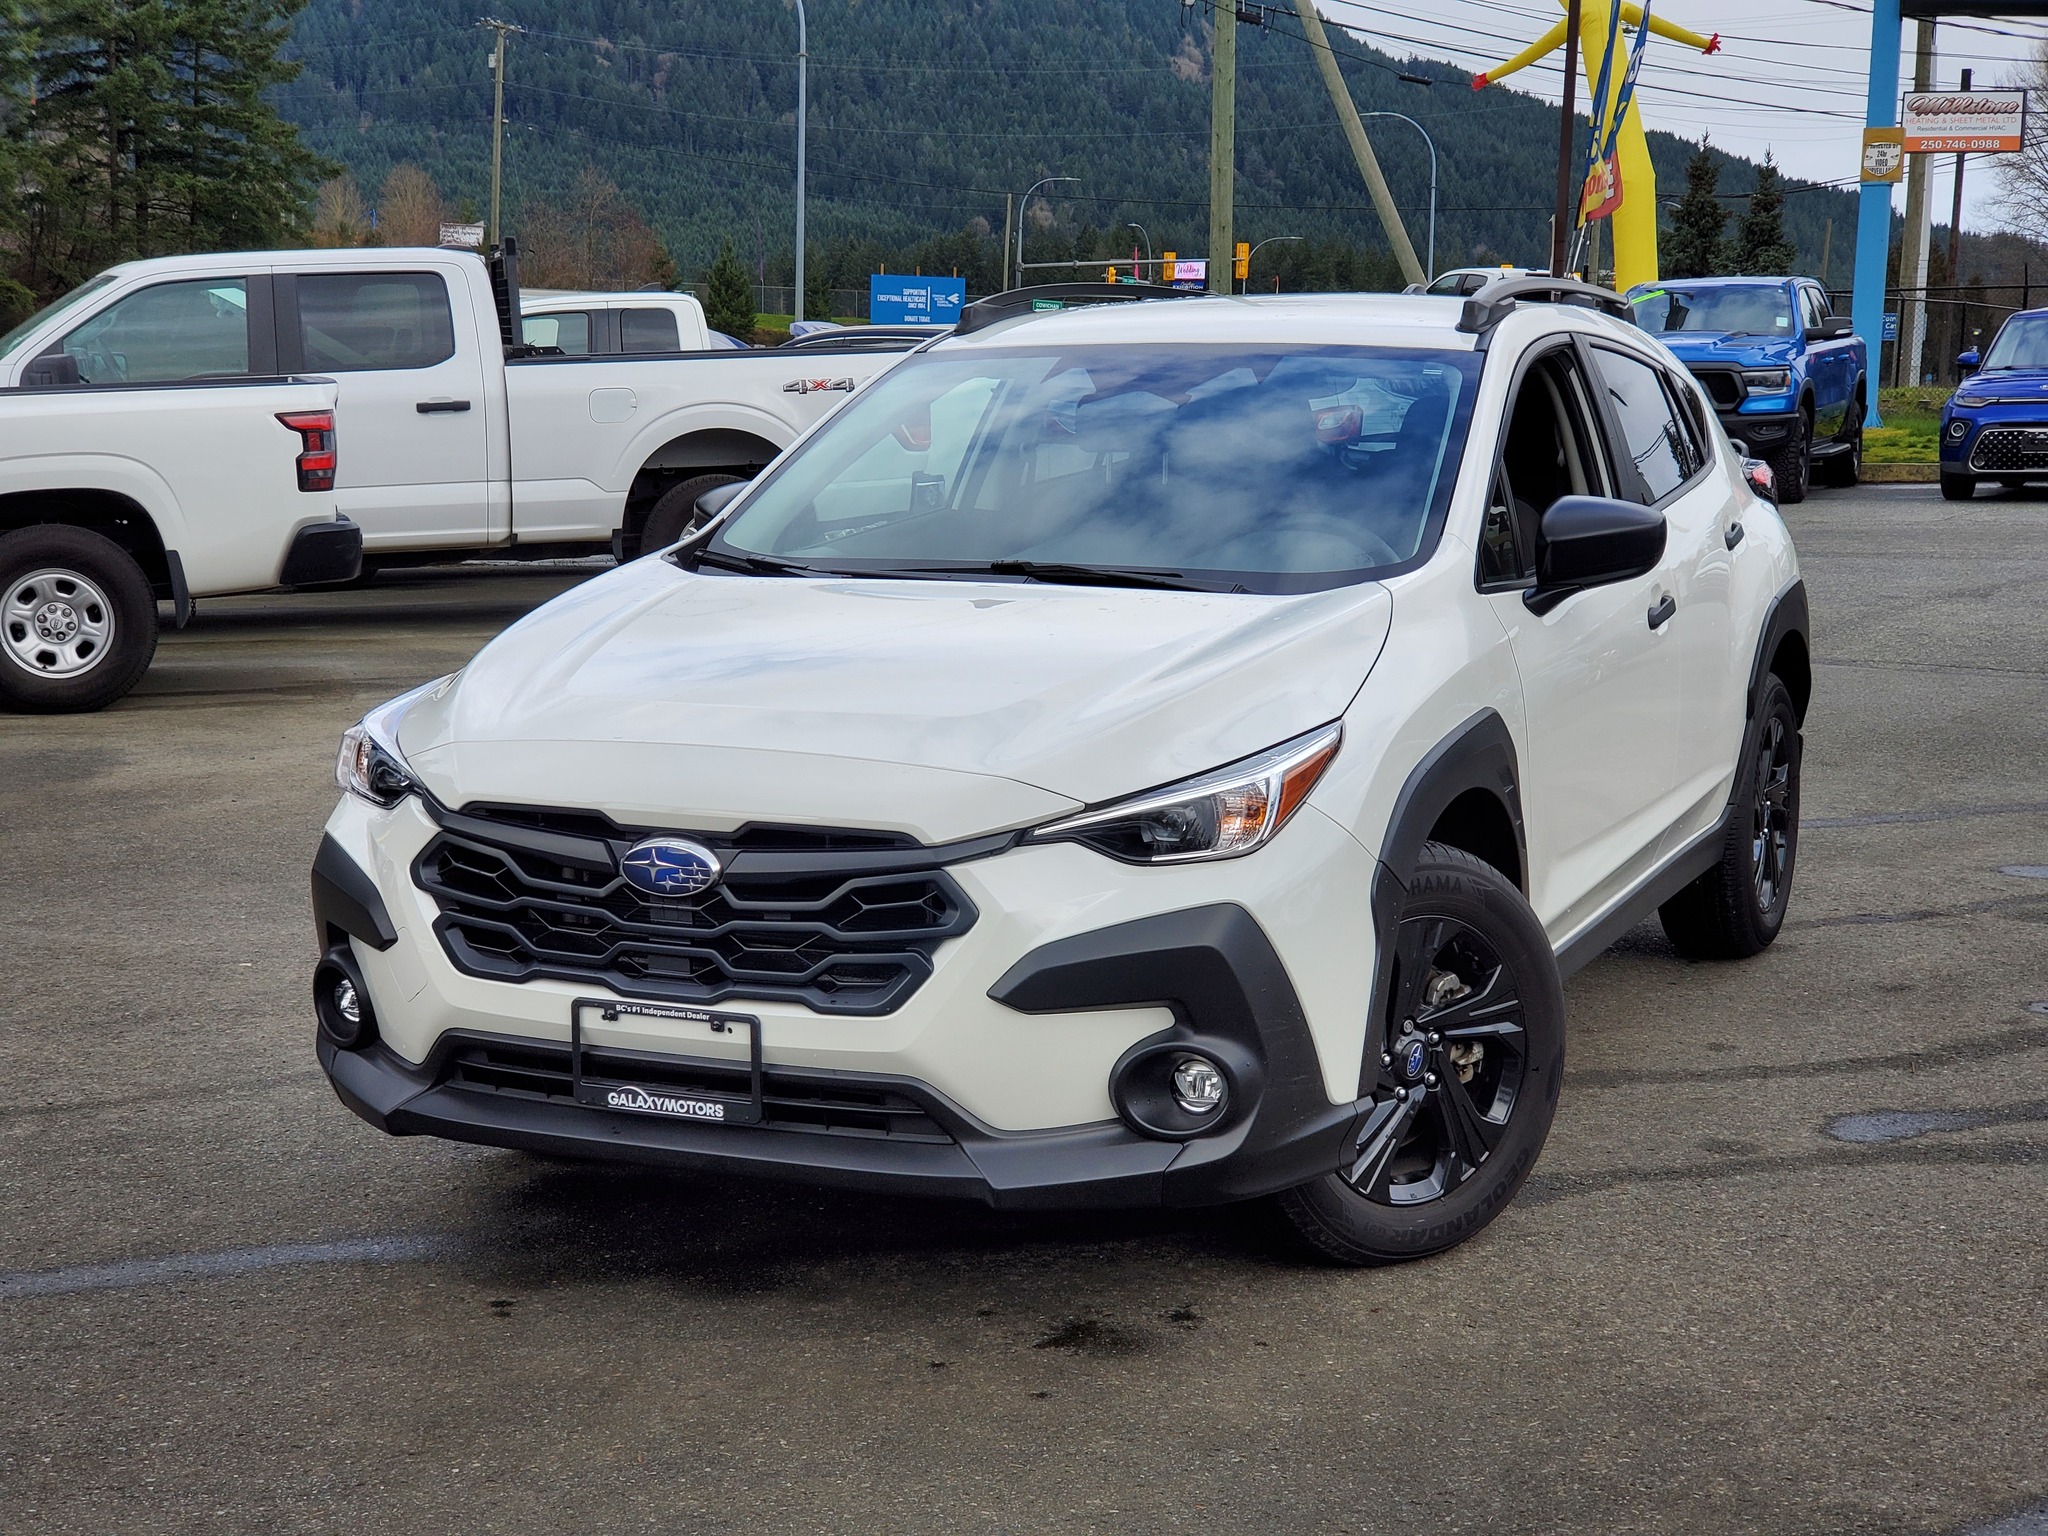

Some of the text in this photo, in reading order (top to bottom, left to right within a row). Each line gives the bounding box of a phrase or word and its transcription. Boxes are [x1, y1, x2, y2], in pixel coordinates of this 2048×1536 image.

[1907, 95, 2020, 117] Millstone
[1920, 140, 2000, 149] 250-746-0988
[1876, 150, 1888, 158] 24hr
[1875, 158, 1889, 167] VIDEO
[1409, 875, 1463, 895] HAMA
[615, 1004, 631, 1012] BC's
[642, 1007, 686, 1018] Independent
[687, 1012, 710, 1020] Dealer
